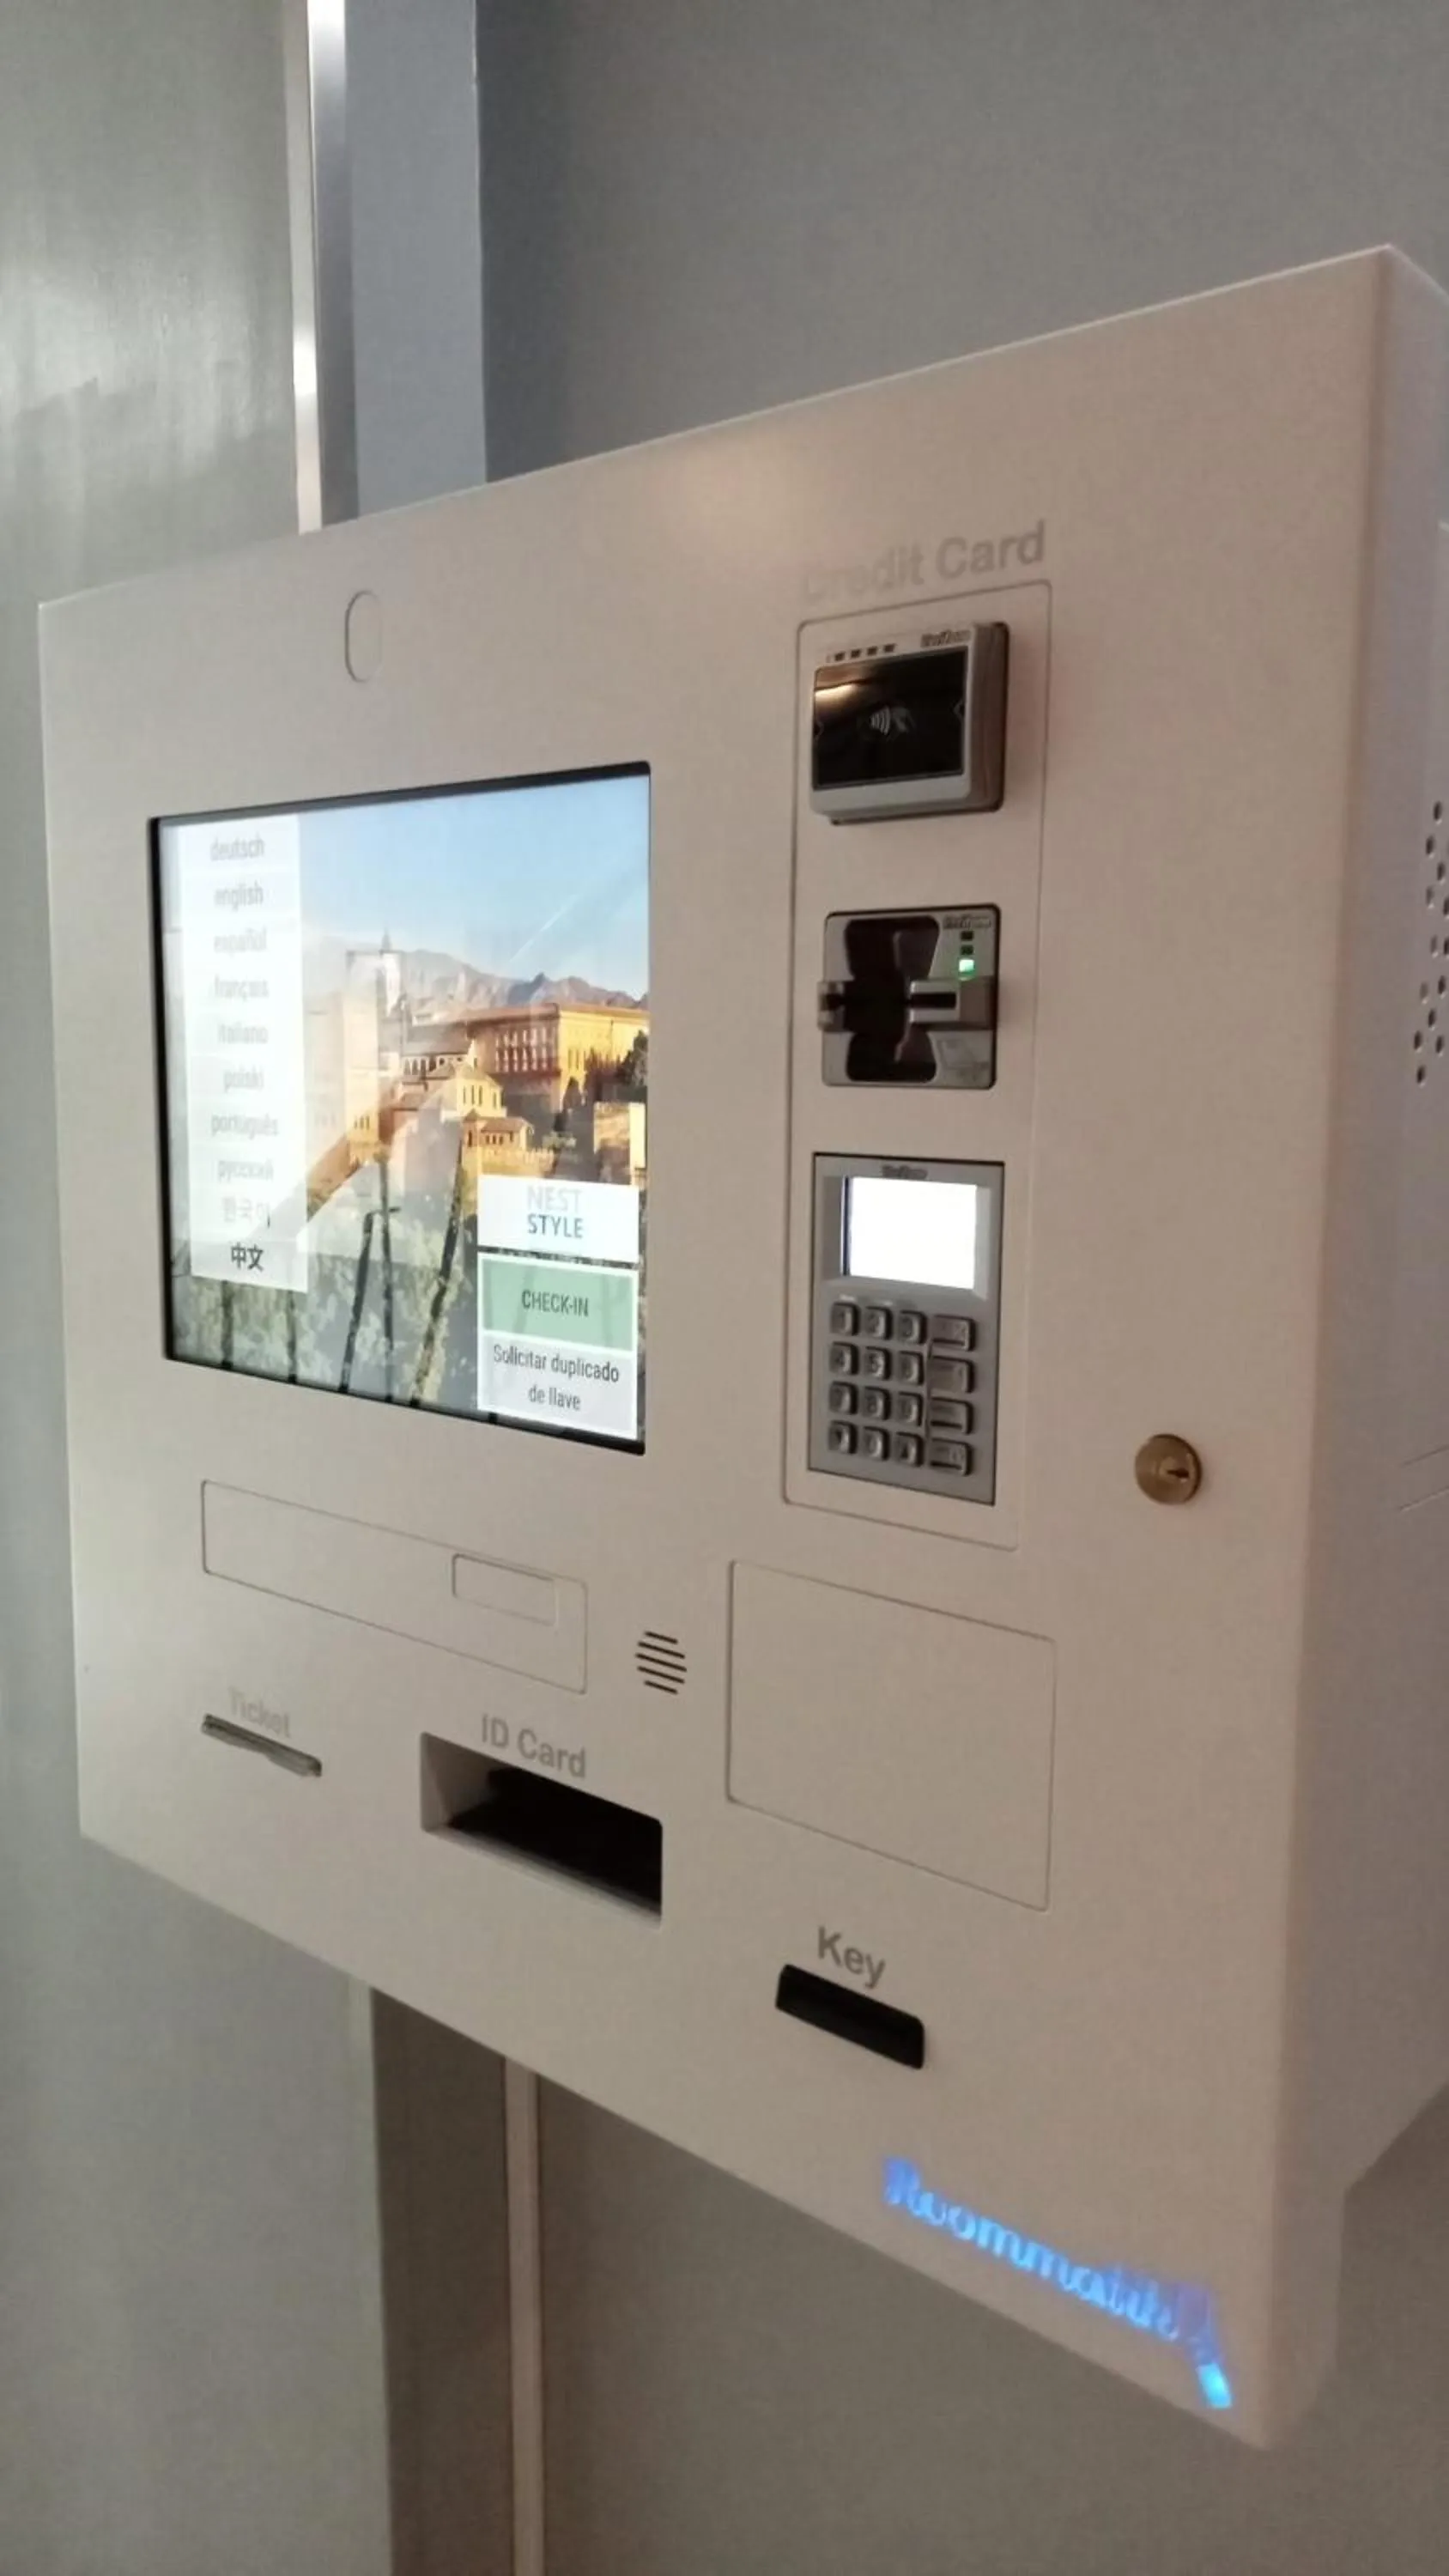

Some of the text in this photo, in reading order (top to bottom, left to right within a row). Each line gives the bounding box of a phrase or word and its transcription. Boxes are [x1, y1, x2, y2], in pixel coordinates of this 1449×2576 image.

[936, 519, 1045, 579] Card
[210, 832, 265, 861] deutsch
[214, 881, 264, 911] english
[527, 1185, 582, 1212] NEST
[527, 1213, 584, 1239] STYLE
[230, 1242, 264, 1272] 中文
[521, 1290, 589, 1317] CHECK-IN
[494, 1344, 620, 1382] Solicitar duplicado
[528, 1384, 581, 1410] de llave
[228, 1688, 291, 1740] Ticket
[481, 1713, 586, 1778] ID Card
[817, 1926, 885, 1989] Key
